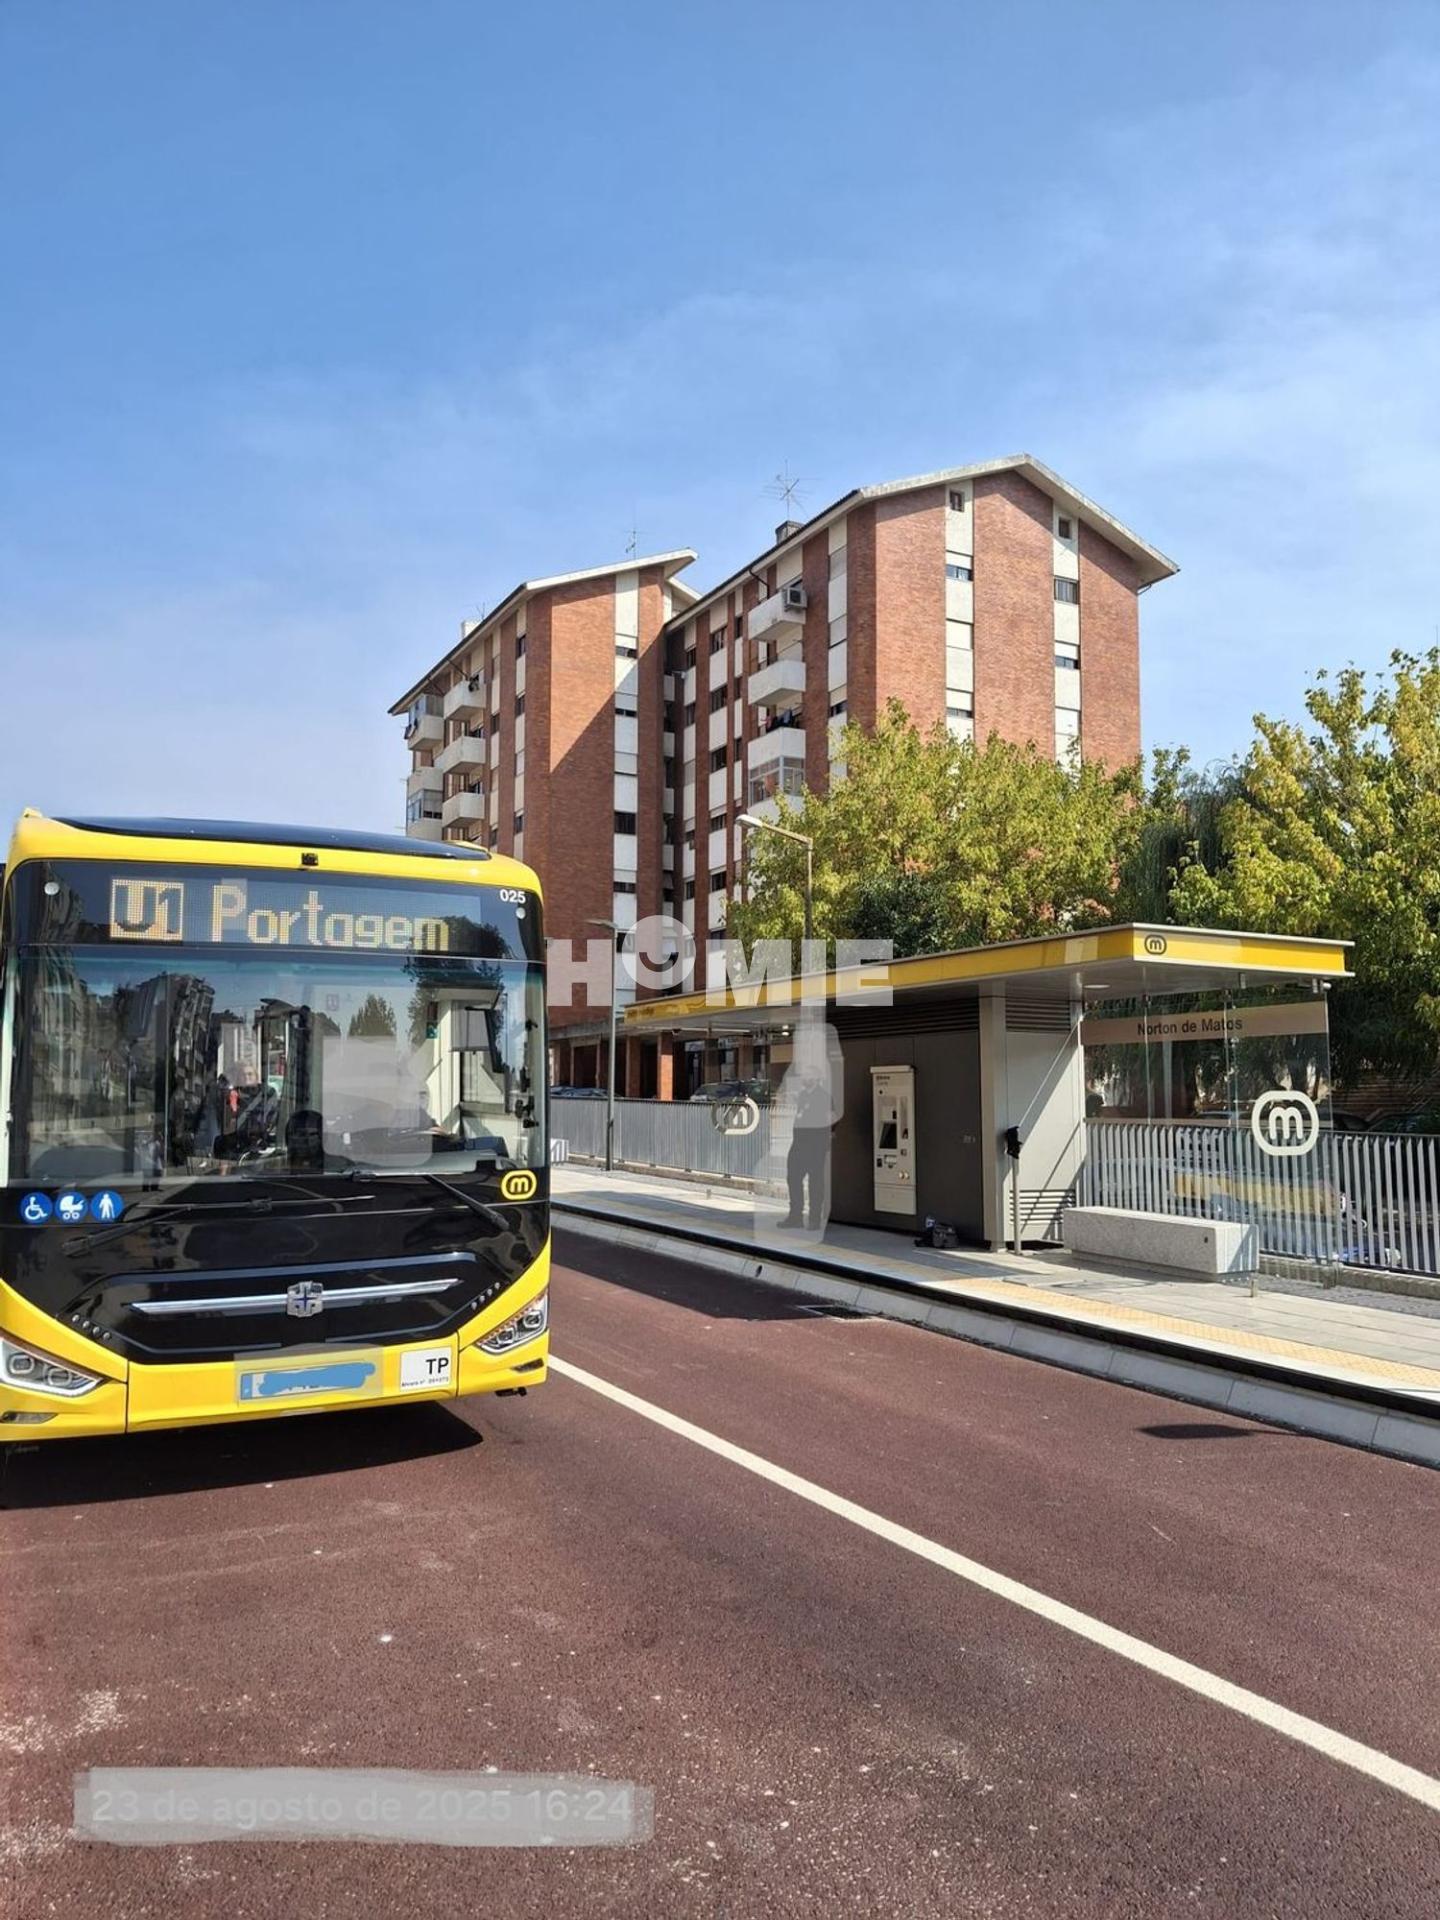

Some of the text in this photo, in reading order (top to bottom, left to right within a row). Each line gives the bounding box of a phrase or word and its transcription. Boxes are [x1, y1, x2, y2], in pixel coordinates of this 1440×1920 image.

[500, 889, 526, 904] 025
[113, 881, 450, 952] U1 Portagem
[1137, 1022, 1177, 1035] Norton
[1181, 1020, 1197, 1032] de
[425, 1357, 449, 1374] TP
